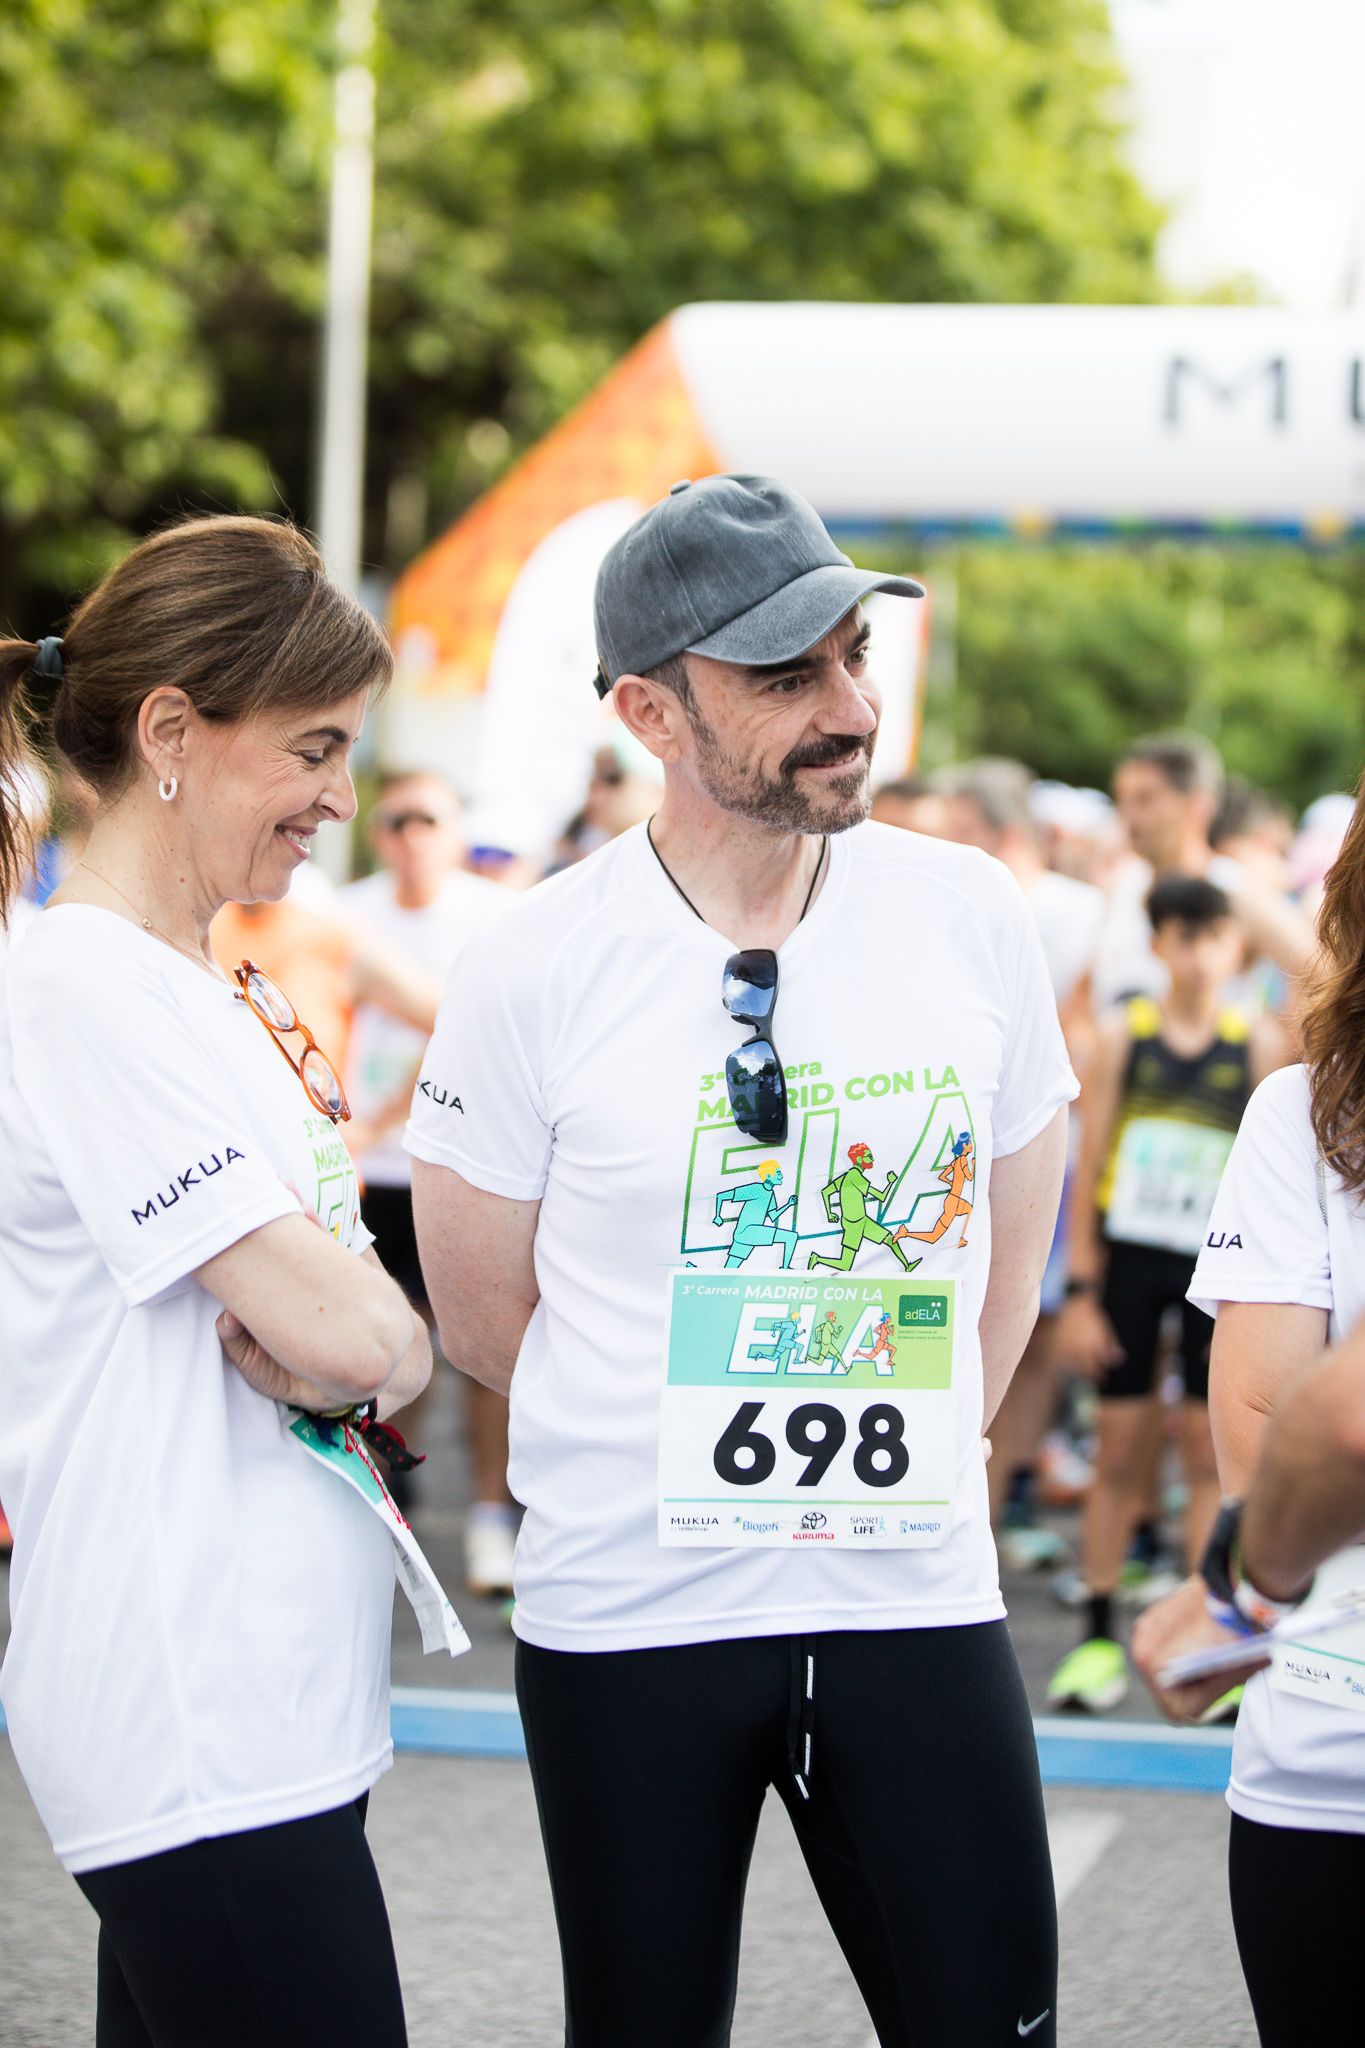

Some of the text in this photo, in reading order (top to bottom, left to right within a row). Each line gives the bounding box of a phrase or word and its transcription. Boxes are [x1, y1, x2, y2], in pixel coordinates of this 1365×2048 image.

[416, 1080, 465, 1115] KUA
[697, 1064, 960, 1122] MARID CON LA
[131, 1146, 246, 1226] MUKUA
[696, 1285, 740, 1296] Carrera
[744, 1284, 818, 1300] MADRID
[823, 1286, 858, 1301] CON
[862, 1287, 883, 1301] LA
[904, 1308, 941, 1321] adELA
[726, 1301, 895, 1377] ELA
[713, 1401, 910, 1488] 698
[671, 1517, 719, 1525] MUKUA
[850, 1516, 879, 1525] SPORT
[909, 1521, 941, 1532] MADRID
[853, 1525, 876, 1534] LIFE
